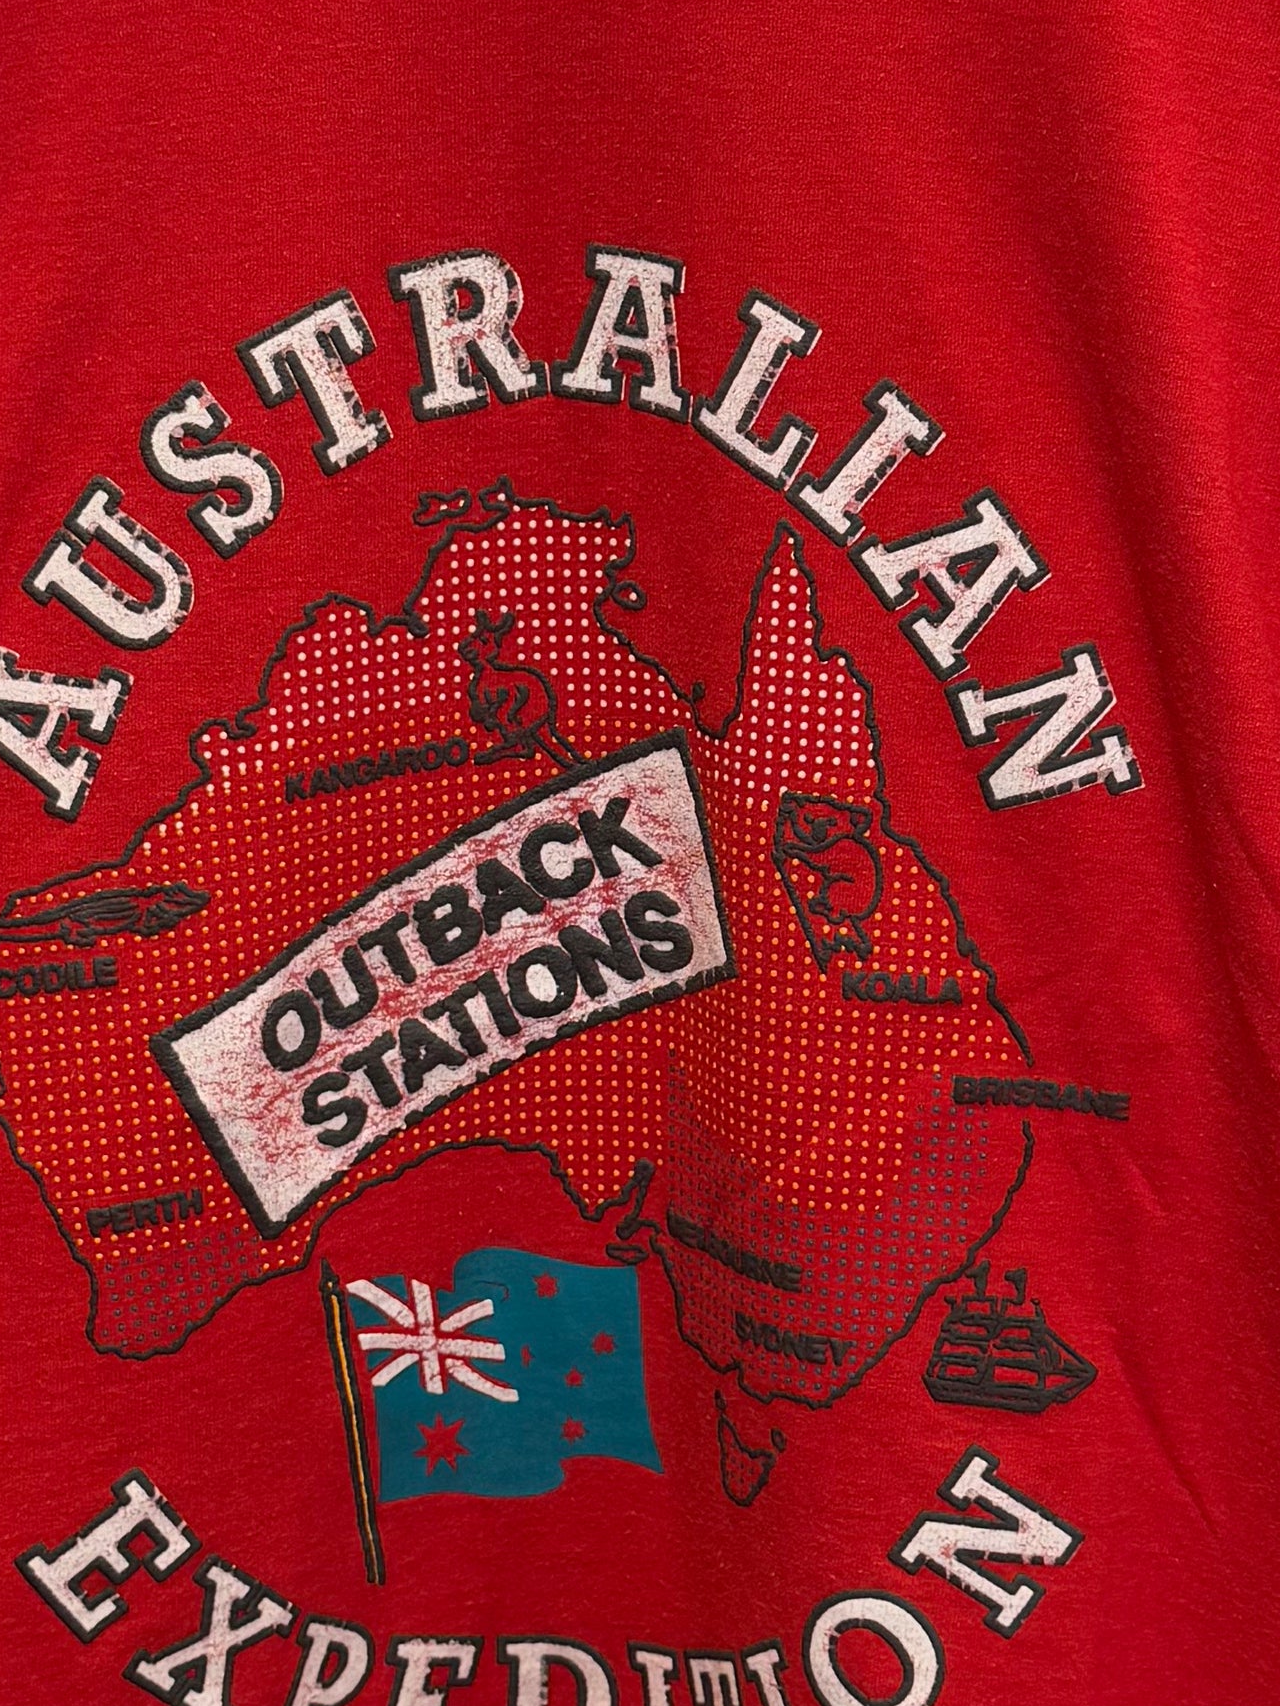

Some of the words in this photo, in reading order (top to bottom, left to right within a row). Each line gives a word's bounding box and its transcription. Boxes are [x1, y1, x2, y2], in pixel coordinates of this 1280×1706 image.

[284, 738, 471, 803] KANGAROO
[259, 796, 665, 1073] OUTBACK
[841, 969, 963, 1006] KOALA
[301, 889, 695, 1152] STATIONS
[951, 1075, 1131, 1122] BRISBANE
[86, 1188, 204, 1238] PERTH
[734, 1311, 857, 1367] SYDNEY
